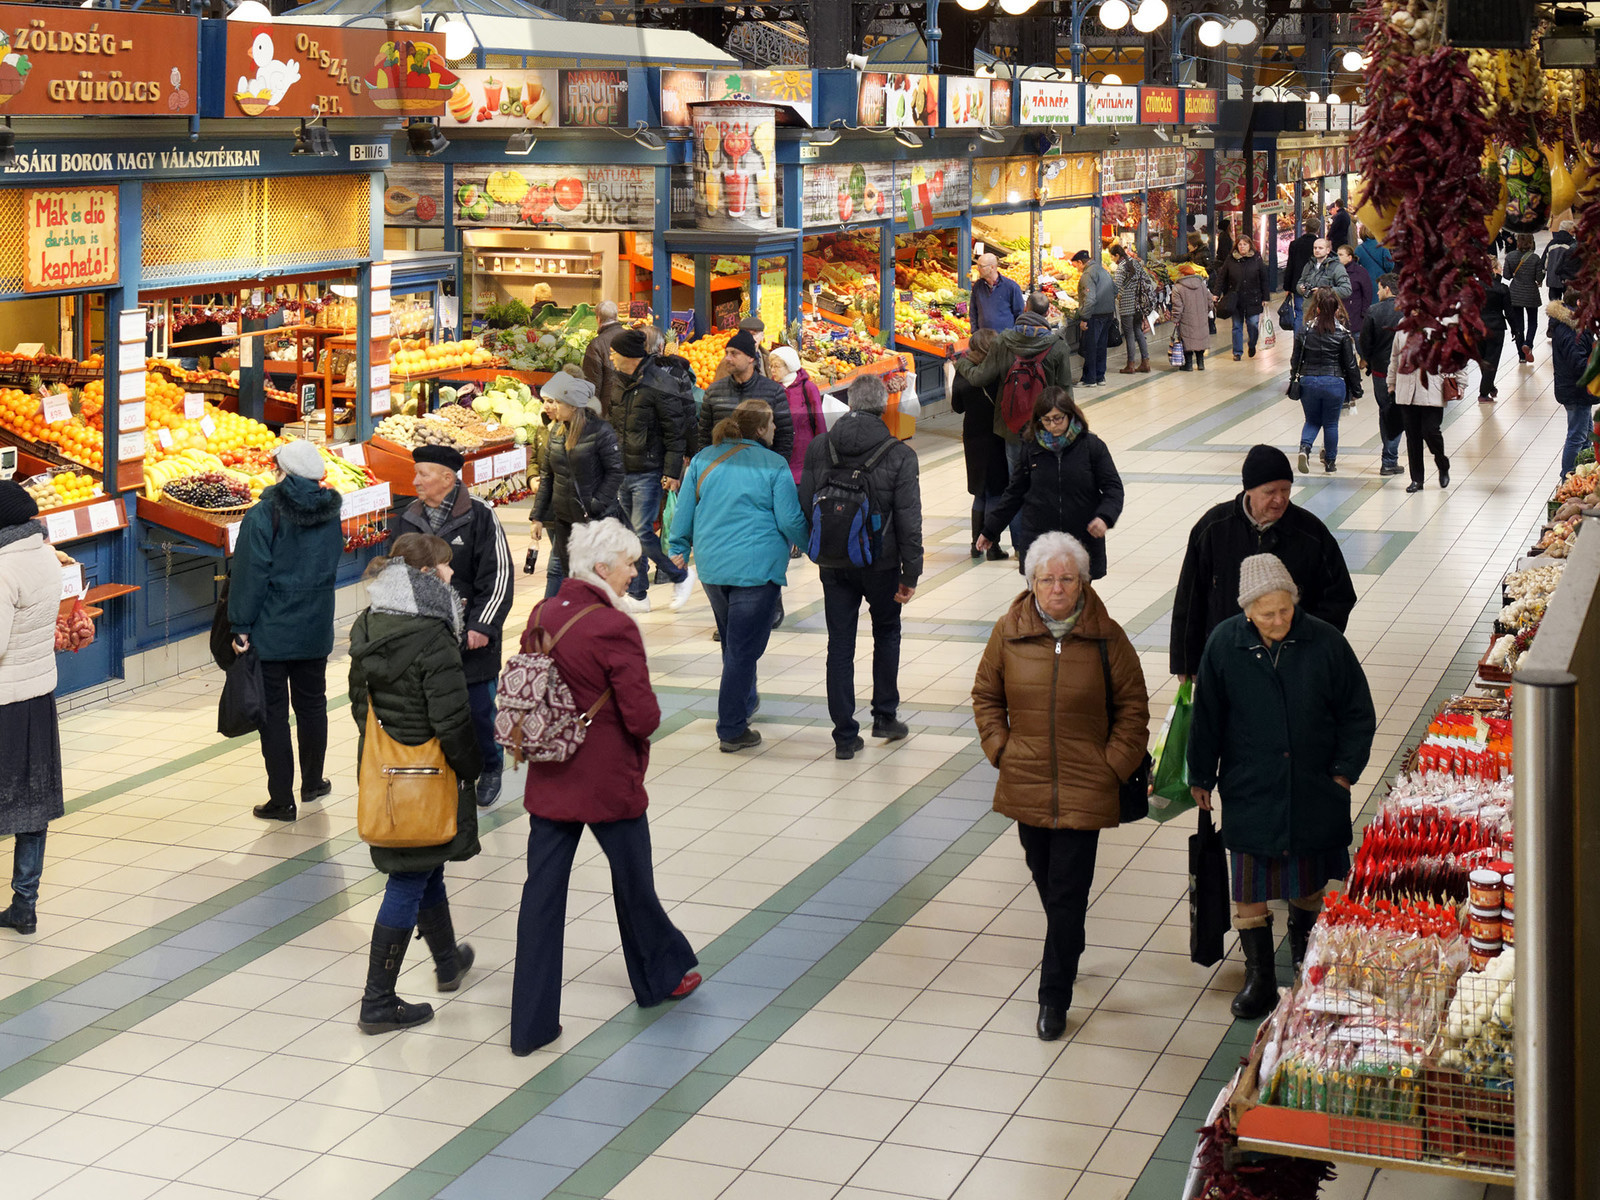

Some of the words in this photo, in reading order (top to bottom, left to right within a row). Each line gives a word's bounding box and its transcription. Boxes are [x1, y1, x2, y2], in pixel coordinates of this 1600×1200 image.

[296, 33, 361, 94] ORSZÁG
[568, 71, 621, 84] NATURAL
[568, 84, 621, 103] FRUIT
[1145, 91, 1172, 113] GYÜMÖLCS
[318, 95, 343, 113] BT.
[565, 105, 618, 125] JUICE
[61, 152, 113, 172] BOROK
[117, 151, 156, 170] NAGY
[160, 146, 260, 169] VÁLASZTÉKBAN
[587, 169, 643, 181] NATURAL
[587, 182, 641, 202] FRUIT
[36, 198, 68, 228] Mák
[71, 203, 81, 223] és
[84, 196, 105, 224] dió
[583, 203, 638, 224] JUICE
[45, 229, 86, 248] darálva
[91, 230, 99, 244] is
[41, 246, 108, 285] kapható!
